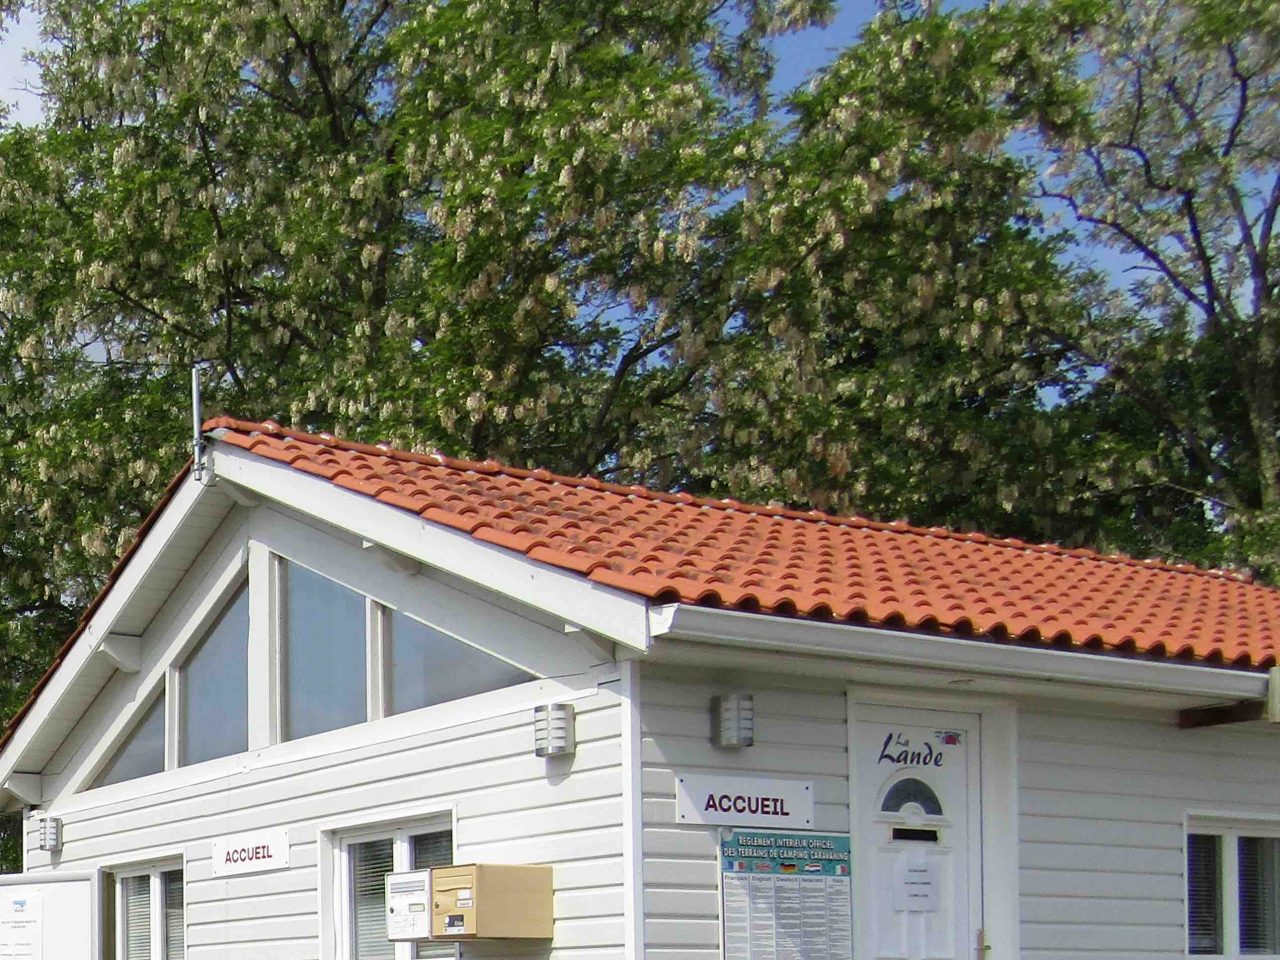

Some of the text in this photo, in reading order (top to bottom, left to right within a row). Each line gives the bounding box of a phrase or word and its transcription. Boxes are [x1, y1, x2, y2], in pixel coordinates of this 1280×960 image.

[877, 732, 944, 767] Lande
[704, 793, 790, 817] ACCUEIL
[224, 844, 273, 864] ACCUEIL
[723, 847, 737, 857] DES
[738, 848, 768, 858] TERRAINS
[769, 849, 778, 858] DE
[779, 850, 809, 859] CAMPING
[809, 840, 835, 849] OFFICIEL
